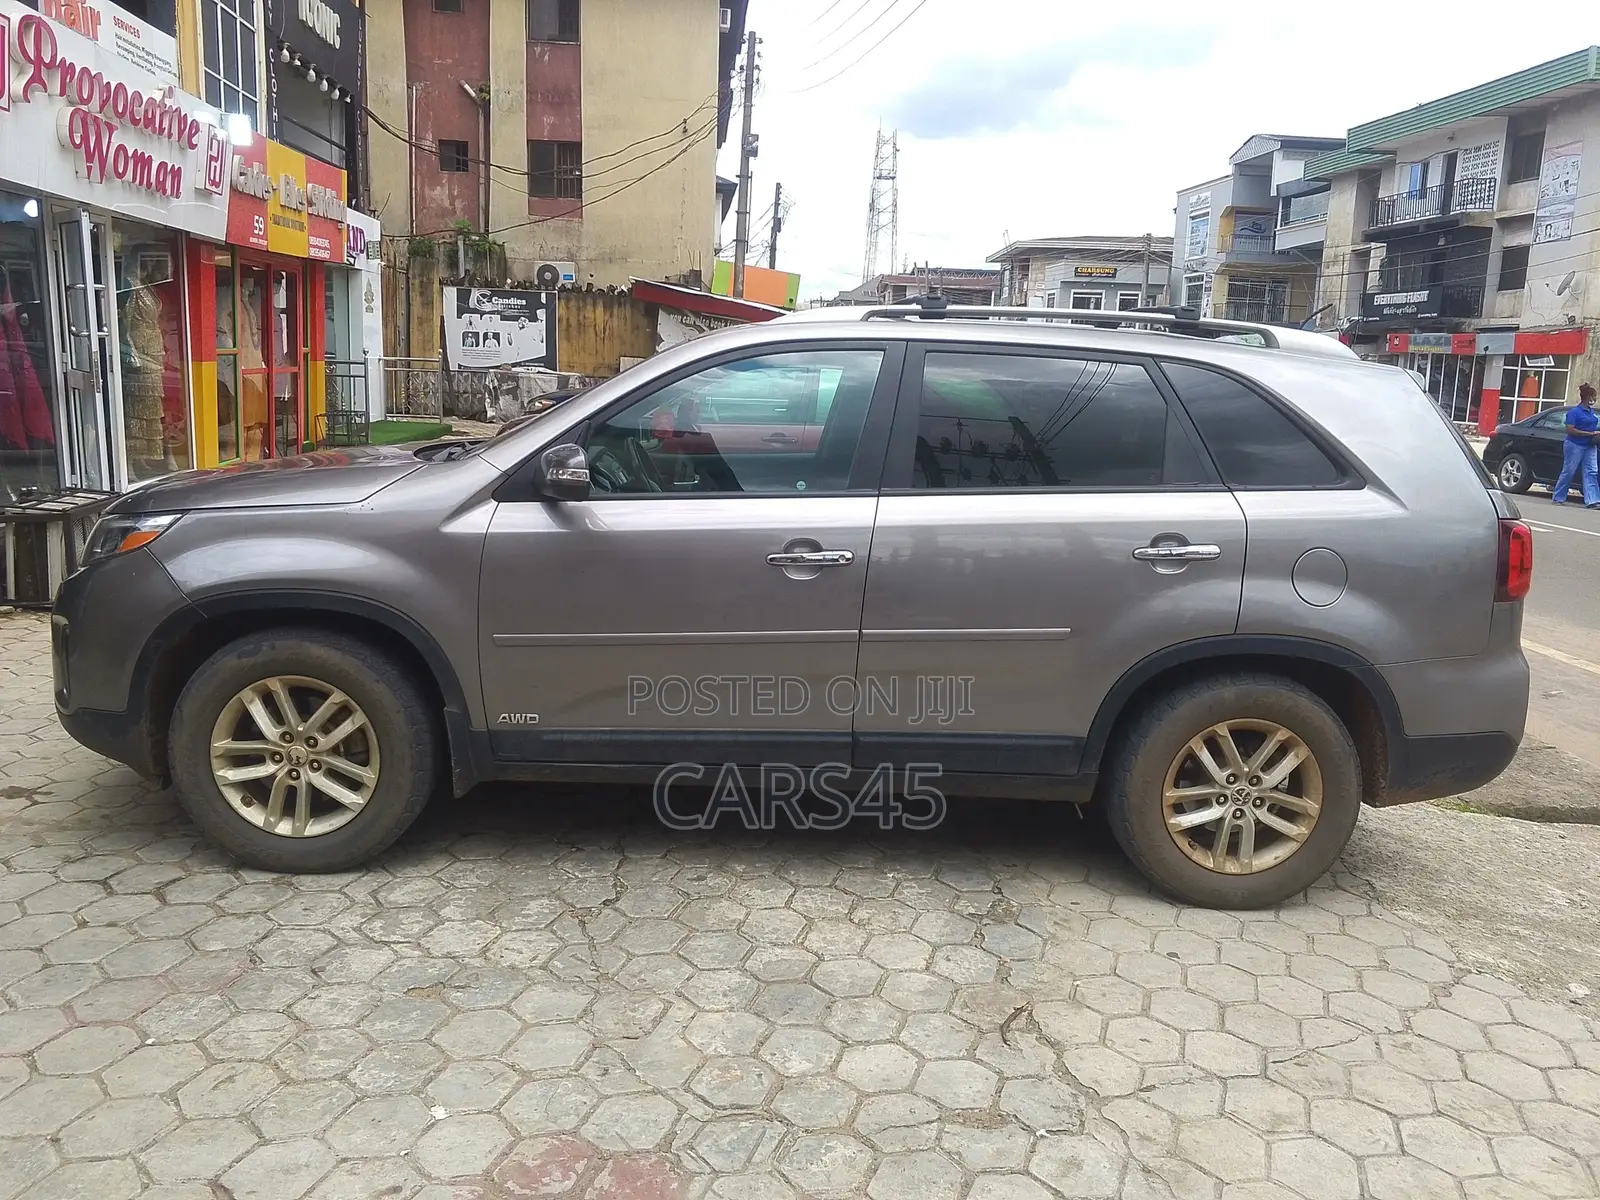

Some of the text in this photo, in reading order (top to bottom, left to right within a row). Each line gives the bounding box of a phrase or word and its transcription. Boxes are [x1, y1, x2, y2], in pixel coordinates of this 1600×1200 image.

[112, 15, 141, 39] SERVICES
[17, 14, 201, 151] Provocative
[68, 107, 183, 199] Woman
[253, 215, 265, 236] 59
[491, 296, 527, 306] Candies
[496, 713, 540, 724] AWD
